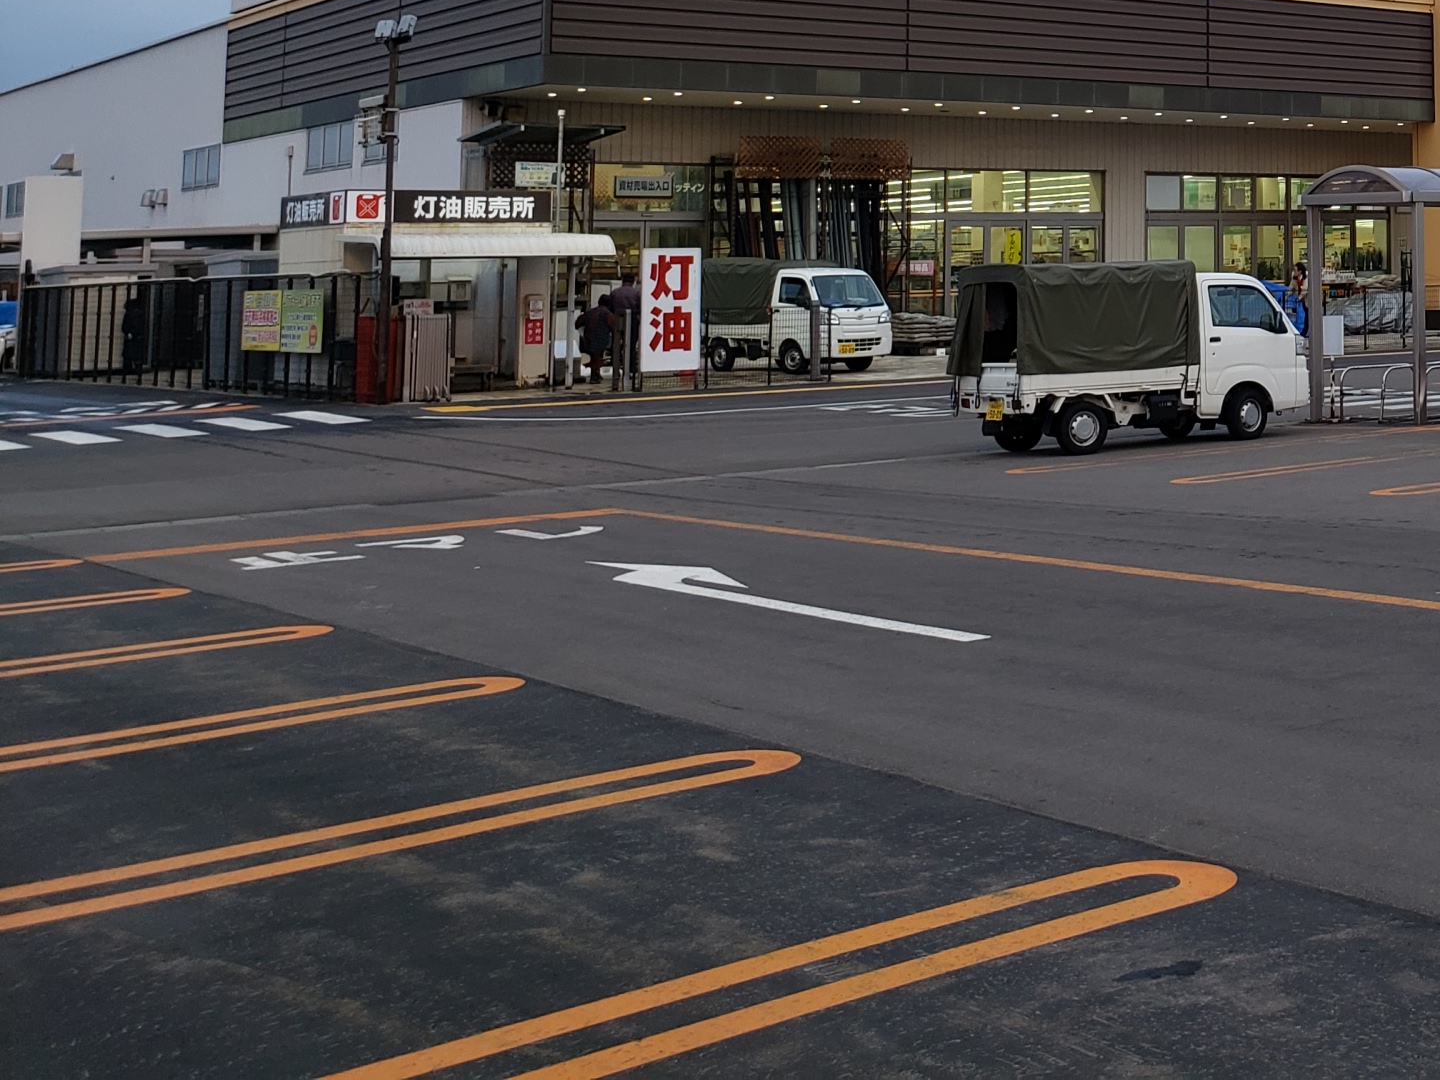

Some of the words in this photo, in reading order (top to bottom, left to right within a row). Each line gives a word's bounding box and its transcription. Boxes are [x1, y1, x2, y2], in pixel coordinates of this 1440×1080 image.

[618, 179, 670, 192] 資材売場出入口
[286, 199, 325, 224] 灯油販売所
[414, 194, 535, 220] 灯油販売所
[648, 254, 695, 354] 灯油
